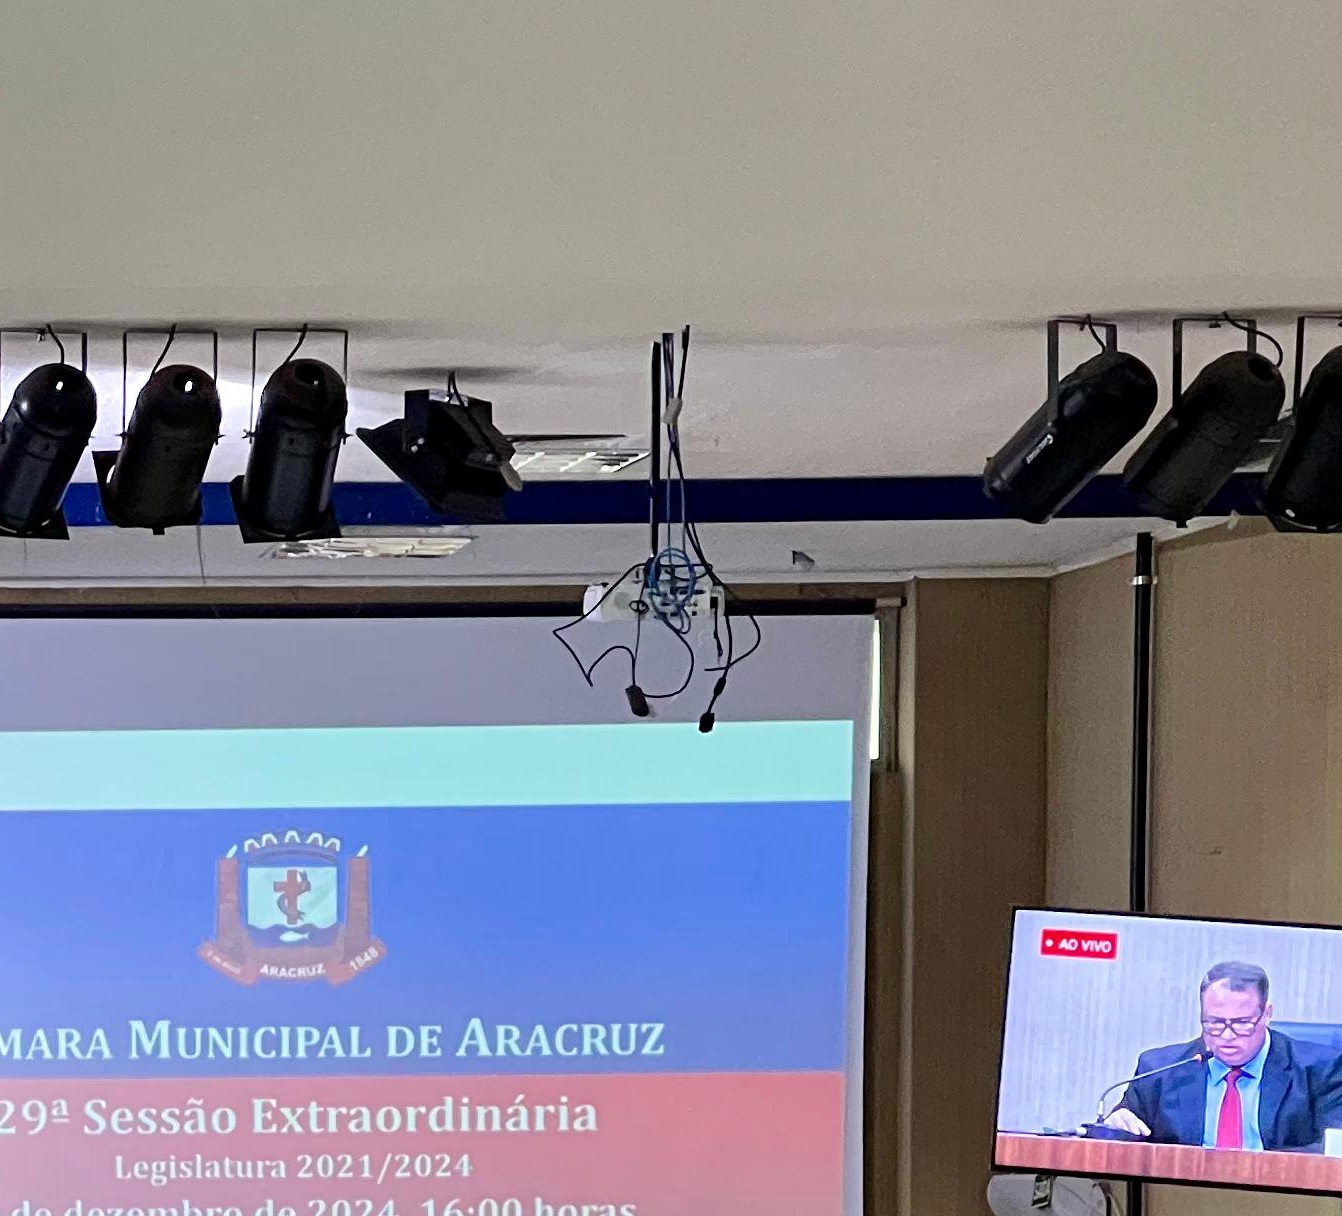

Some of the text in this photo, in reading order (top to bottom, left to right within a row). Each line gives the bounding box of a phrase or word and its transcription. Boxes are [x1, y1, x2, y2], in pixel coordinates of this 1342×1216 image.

[1058, 938, 1112, 953] AO VIVO
[259, 962, 326, 979] ARACRUZ
[128, 1019, 372, 1060] MUNICIPAL
[455, 1017, 665, 1058] ARACRUZ
[83, 1097, 237, 1136] Sessão
[251, 1093, 598, 1135] Extraordinária
[115, 1152, 473, 1187] Legislatura 2021/2024
